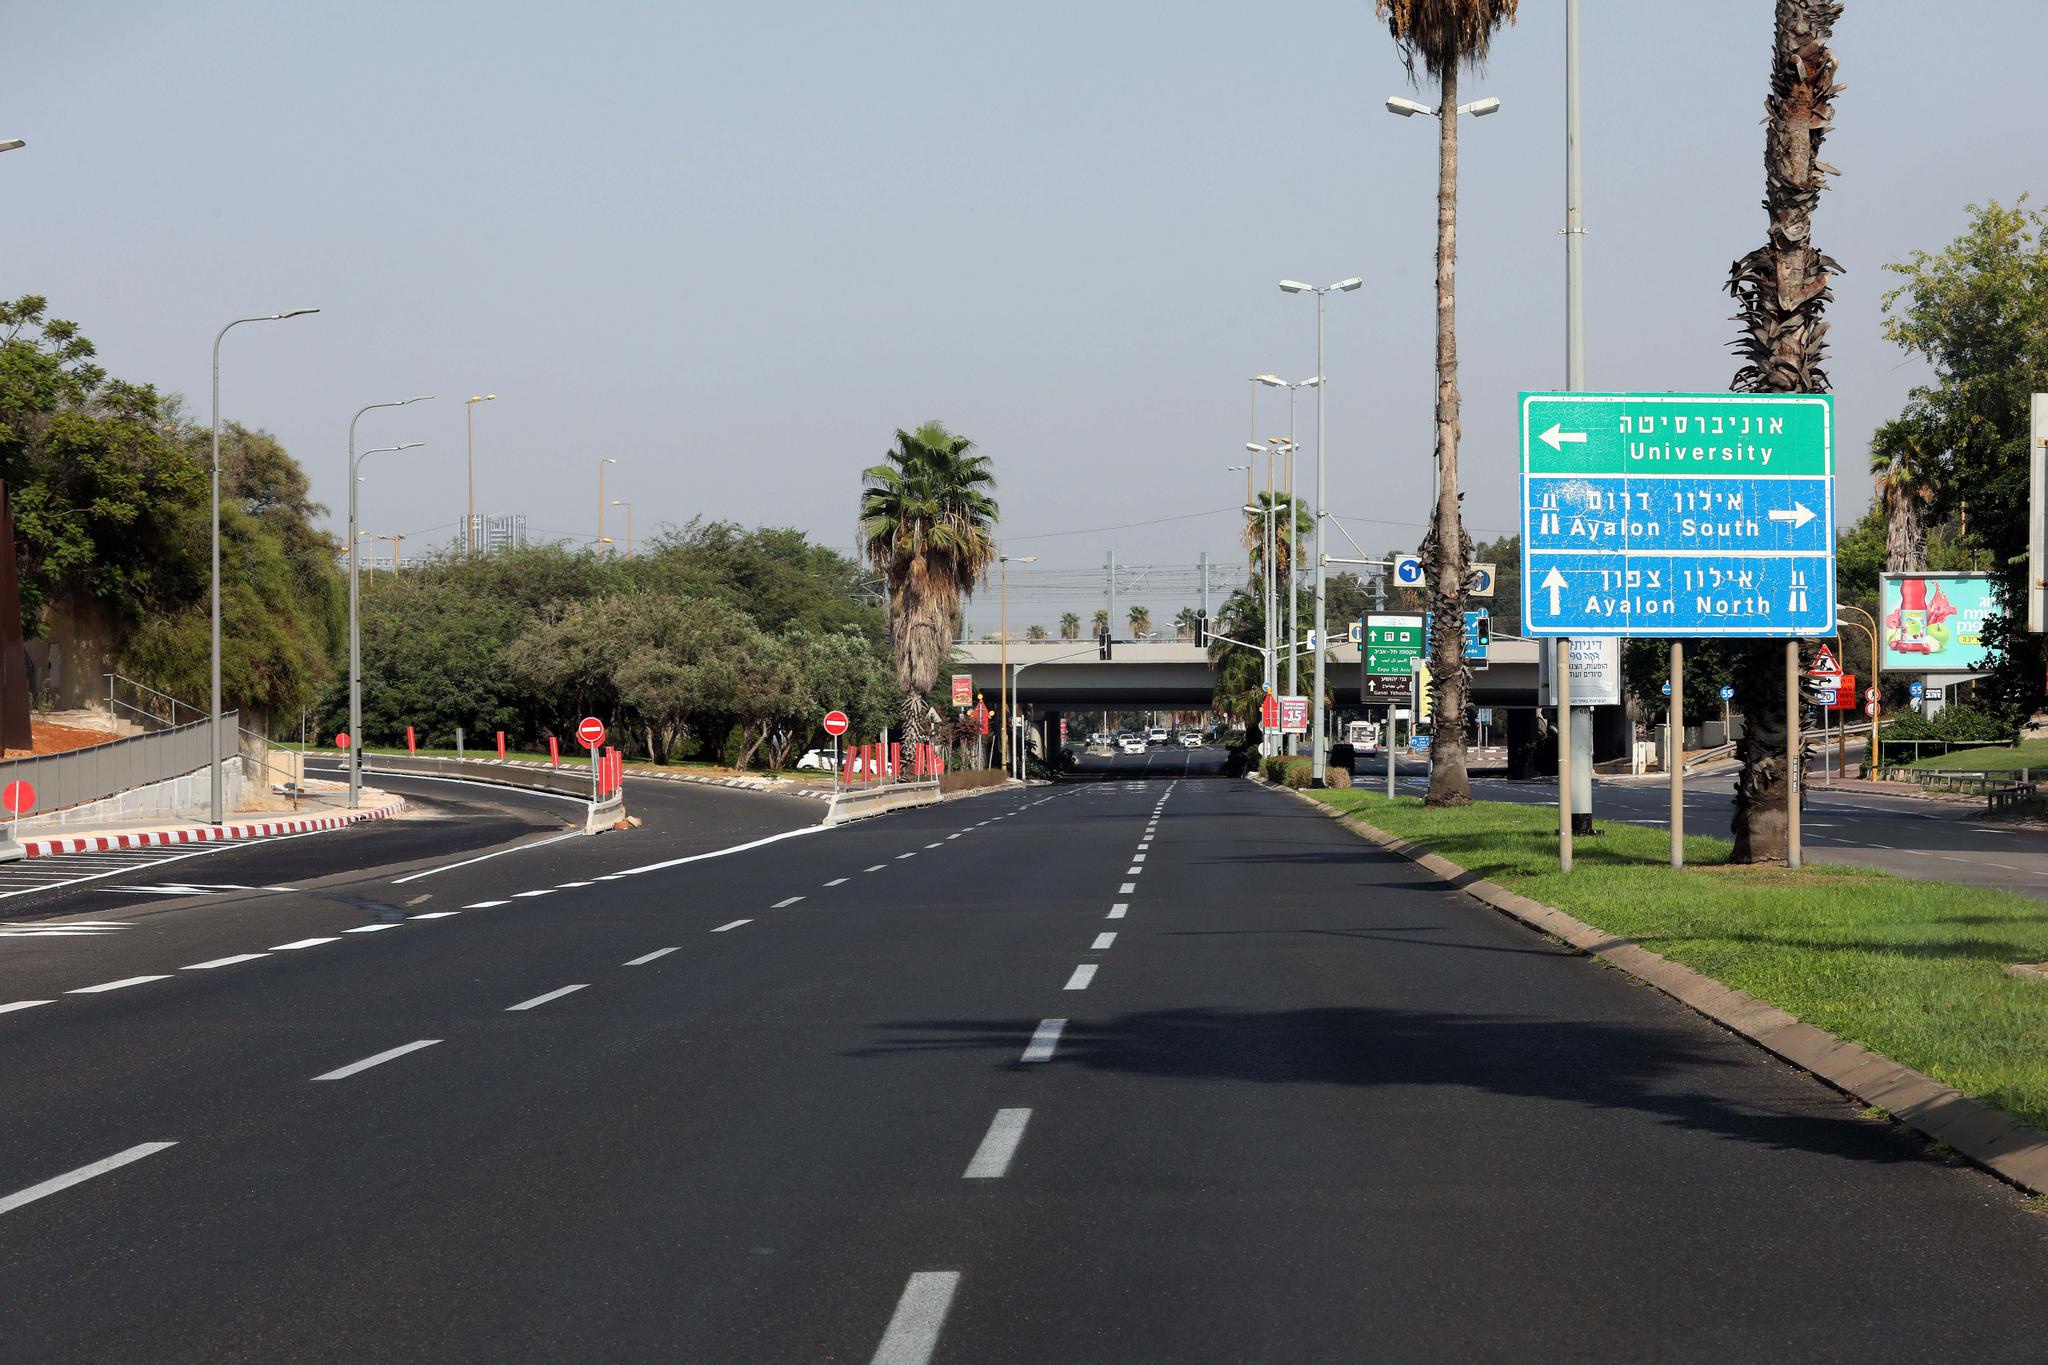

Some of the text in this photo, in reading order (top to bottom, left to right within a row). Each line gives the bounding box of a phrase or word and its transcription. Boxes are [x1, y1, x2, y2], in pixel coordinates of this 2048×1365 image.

[1619, 416, 1784, 434] אוניברסיטה
[1631, 442, 1773, 465] University
[1588, 492, 1742, 514] אילון דרום
[1570, 519, 1759, 541] Ayalon South
[1601, 568, 1753, 592] אילון צפון
[1585, 597, 1771, 618] Ayalon North
[1569, 652, 1582, 661] 90
[1912, 686, 1922, 695] 55
[1287, 711, 1302, 722] 15
